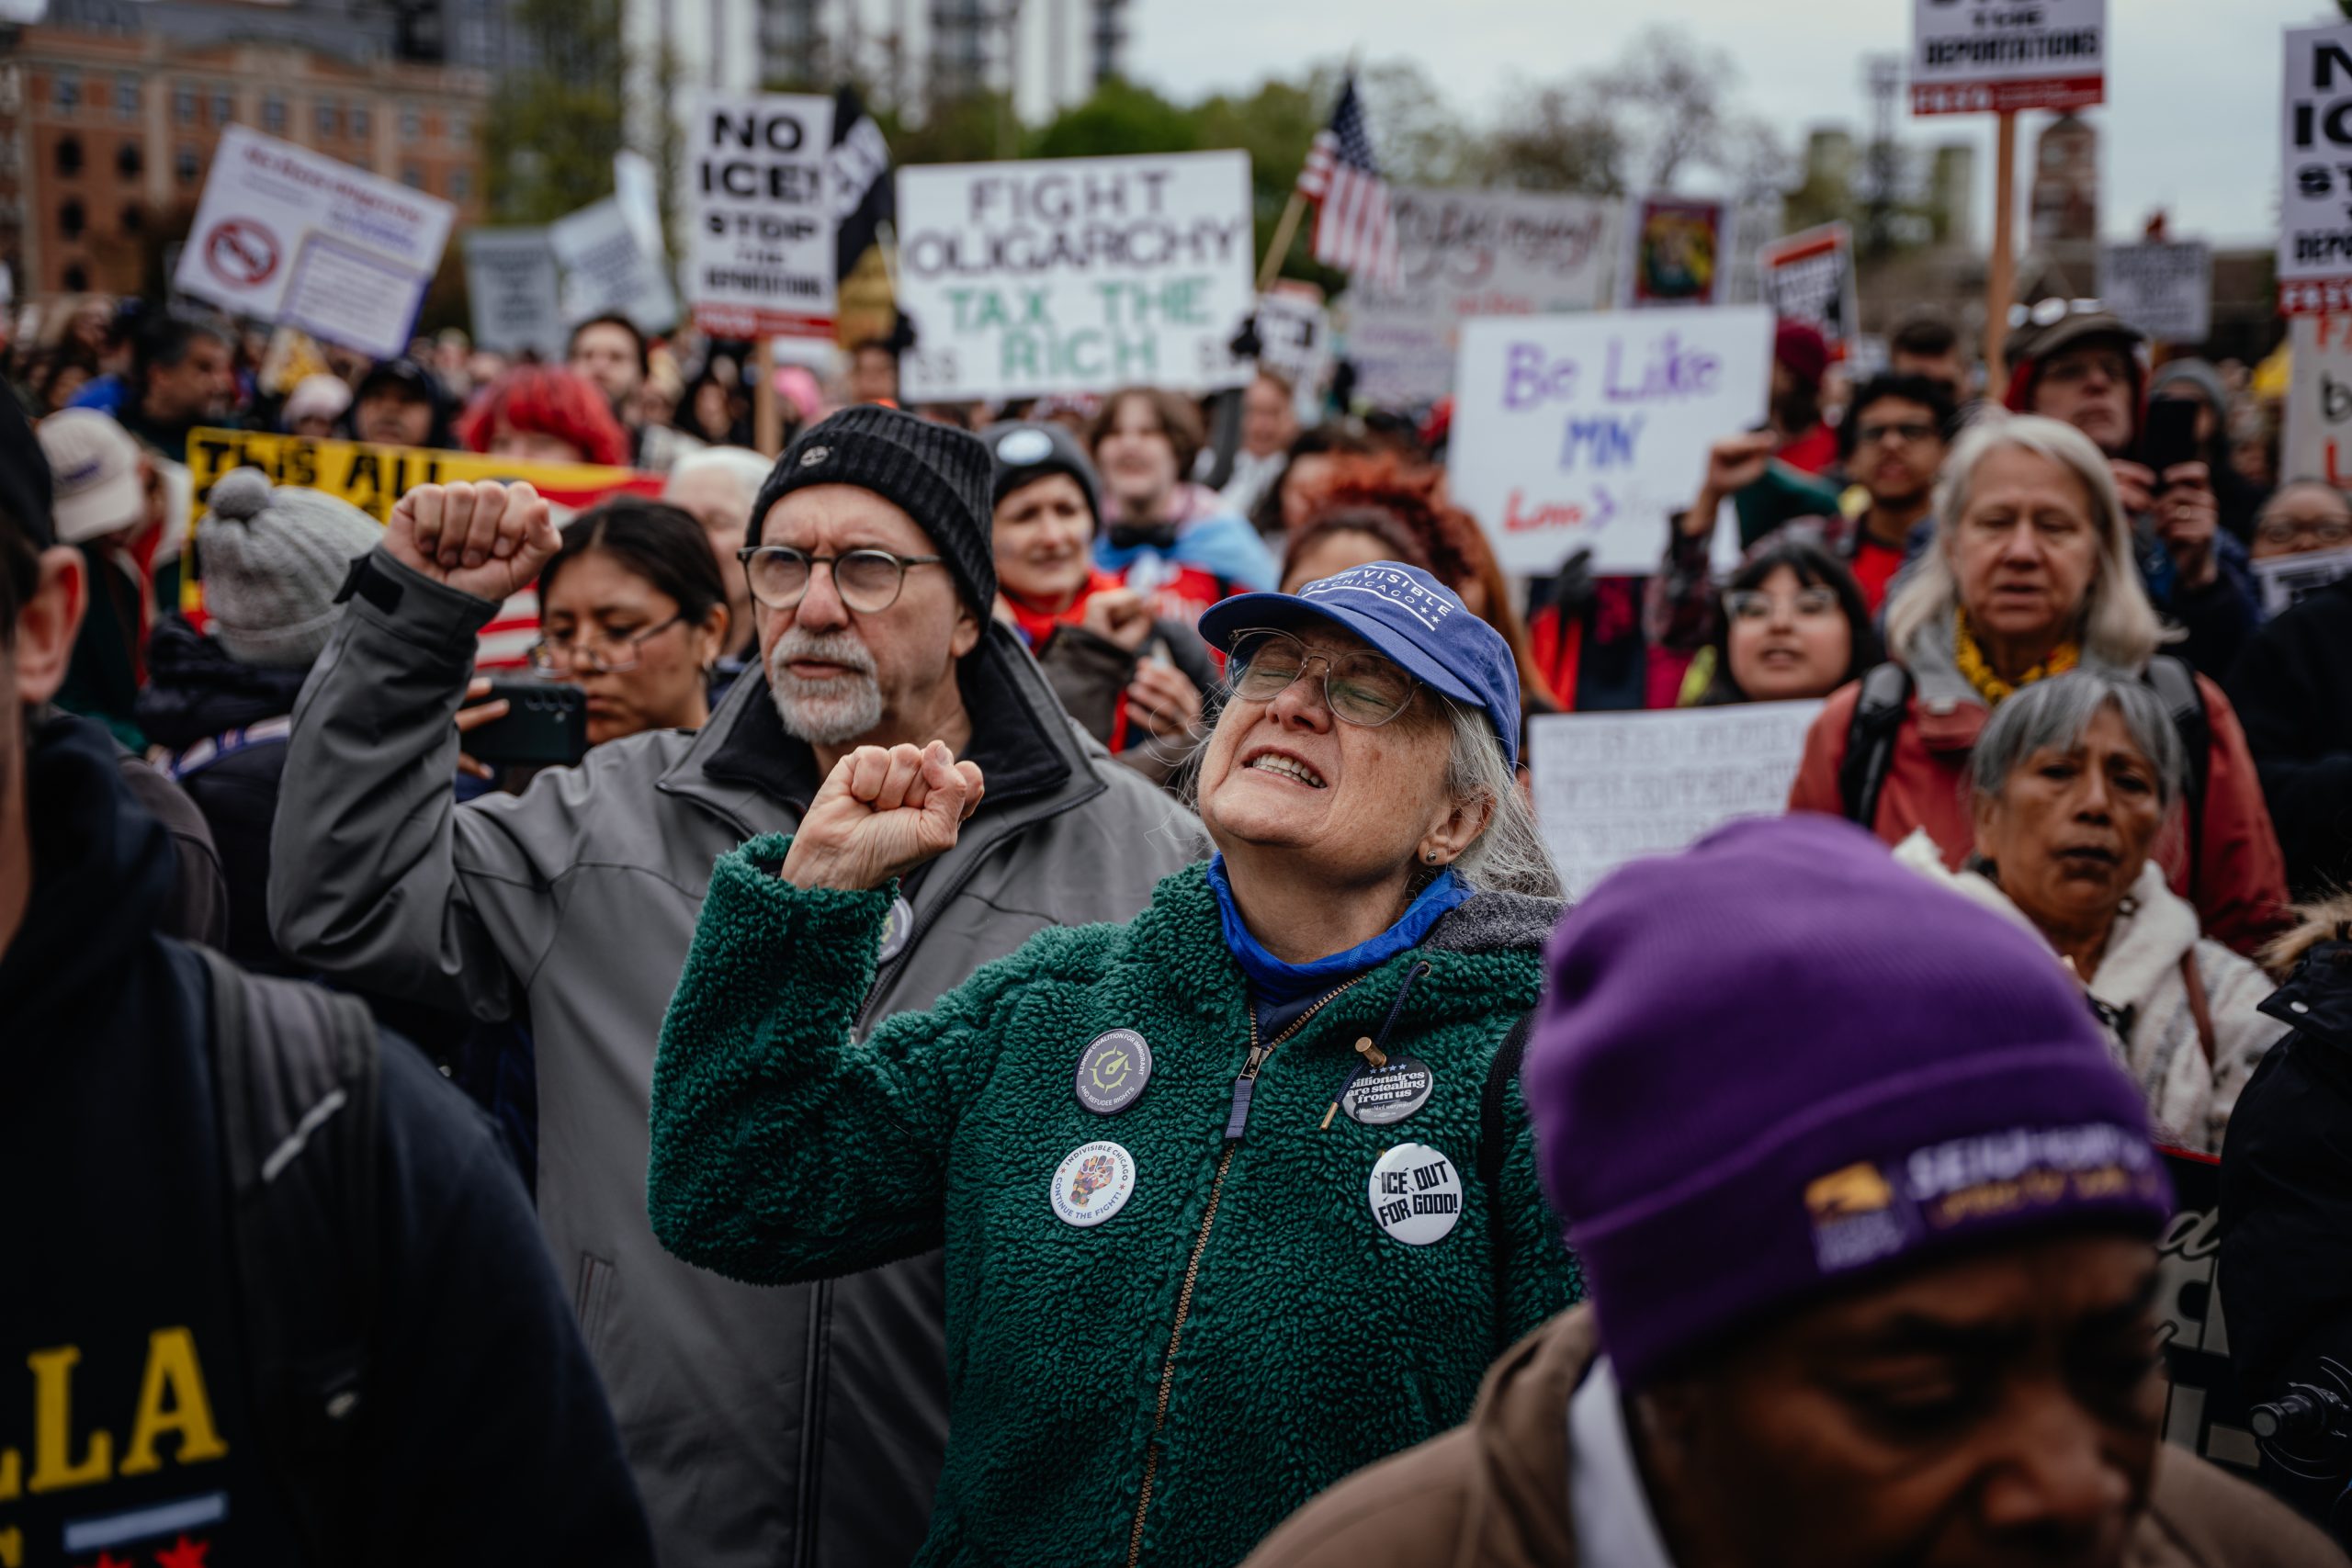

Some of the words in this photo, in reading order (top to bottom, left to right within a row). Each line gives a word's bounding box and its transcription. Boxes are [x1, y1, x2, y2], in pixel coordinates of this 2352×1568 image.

[1924, 28, 2098, 66] DEPORTATIONS
[2312, 41, 2352, 90] N
[713, 110, 804, 152] NO
[2293, 99, 2352, 152] IC
[701, 161, 820, 202] ICE!
[968, 169, 1173, 225] FIGHT
[906, 217, 1244, 279] OLIGARCHY
[943, 282, 1053, 332] TAX
[1094, 276, 1214, 326] THE
[1000, 328, 1158, 379] RICH
[1503, 342, 1579, 411] Be
[1604, 329, 1721, 402] Like
[1331, 579, 1416, 604] CHICAGO
[1079, 1048, 1093, 1075] ILLINOIS
[1091, 1032, 1124, 1050] COALITION
[1123, 1033, 1136, 1043] FOR
[1133, 1040, 1146, 1076] IMMIGRANT
[1080, 1085, 1091, 1098] AND
[1088, 1094, 1114, 1106] REFUGEE
[1113, 1086, 1135, 1104] RIGHTS
[1346, 1087, 1370, 1098] are
[1371, 1079, 1425, 1093] stealing
[1357, 1091, 1394, 1103] from
[1395, 1089, 1412, 1098] us
[1065, 1145, 1113, 1166] INDIVISIBLE
[1112, 1149, 1129, 1181] CHICAGO
[1381, 1171, 1408, 1195] ICE
[1413, 1160, 1449, 1190] OUT
[1055, 1177, 1074, 1217] CONTINUE
[1075, 1212, 1092, 1220] THE
[1094, 1191, 1122, 1217] FIGHT!
[1378, 1198, 1412, 1227] FOR
[1413, 1193, 1458, 1215] GOOD!
[0, 1327, 228, 1501] LA
